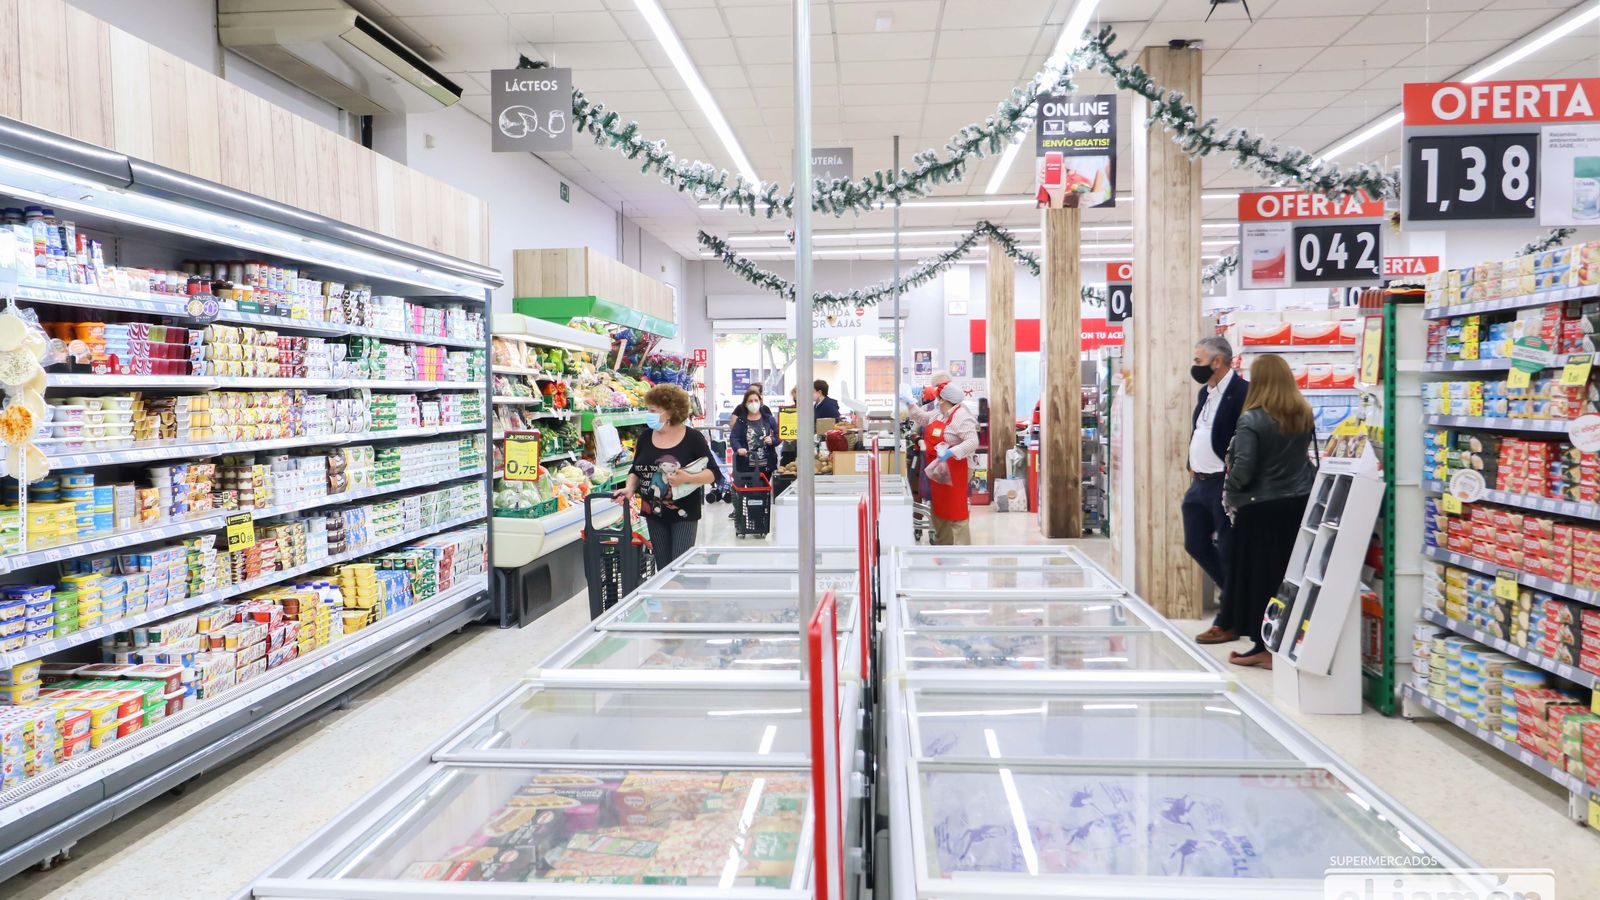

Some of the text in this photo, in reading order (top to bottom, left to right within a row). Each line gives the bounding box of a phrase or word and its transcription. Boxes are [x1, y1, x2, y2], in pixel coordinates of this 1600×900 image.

[505, 78, 558, 92] LÁCTEOS
[1042, 101, 1110, 117] ONLINE
[1431, 82, 1594, 121] OFERTA
[1042, 137, 1111, 148] ¡ENVÍO GRATIS!
[1095, 331, 1106, 340] TU
[506, 459, 537, 476] 0,75
